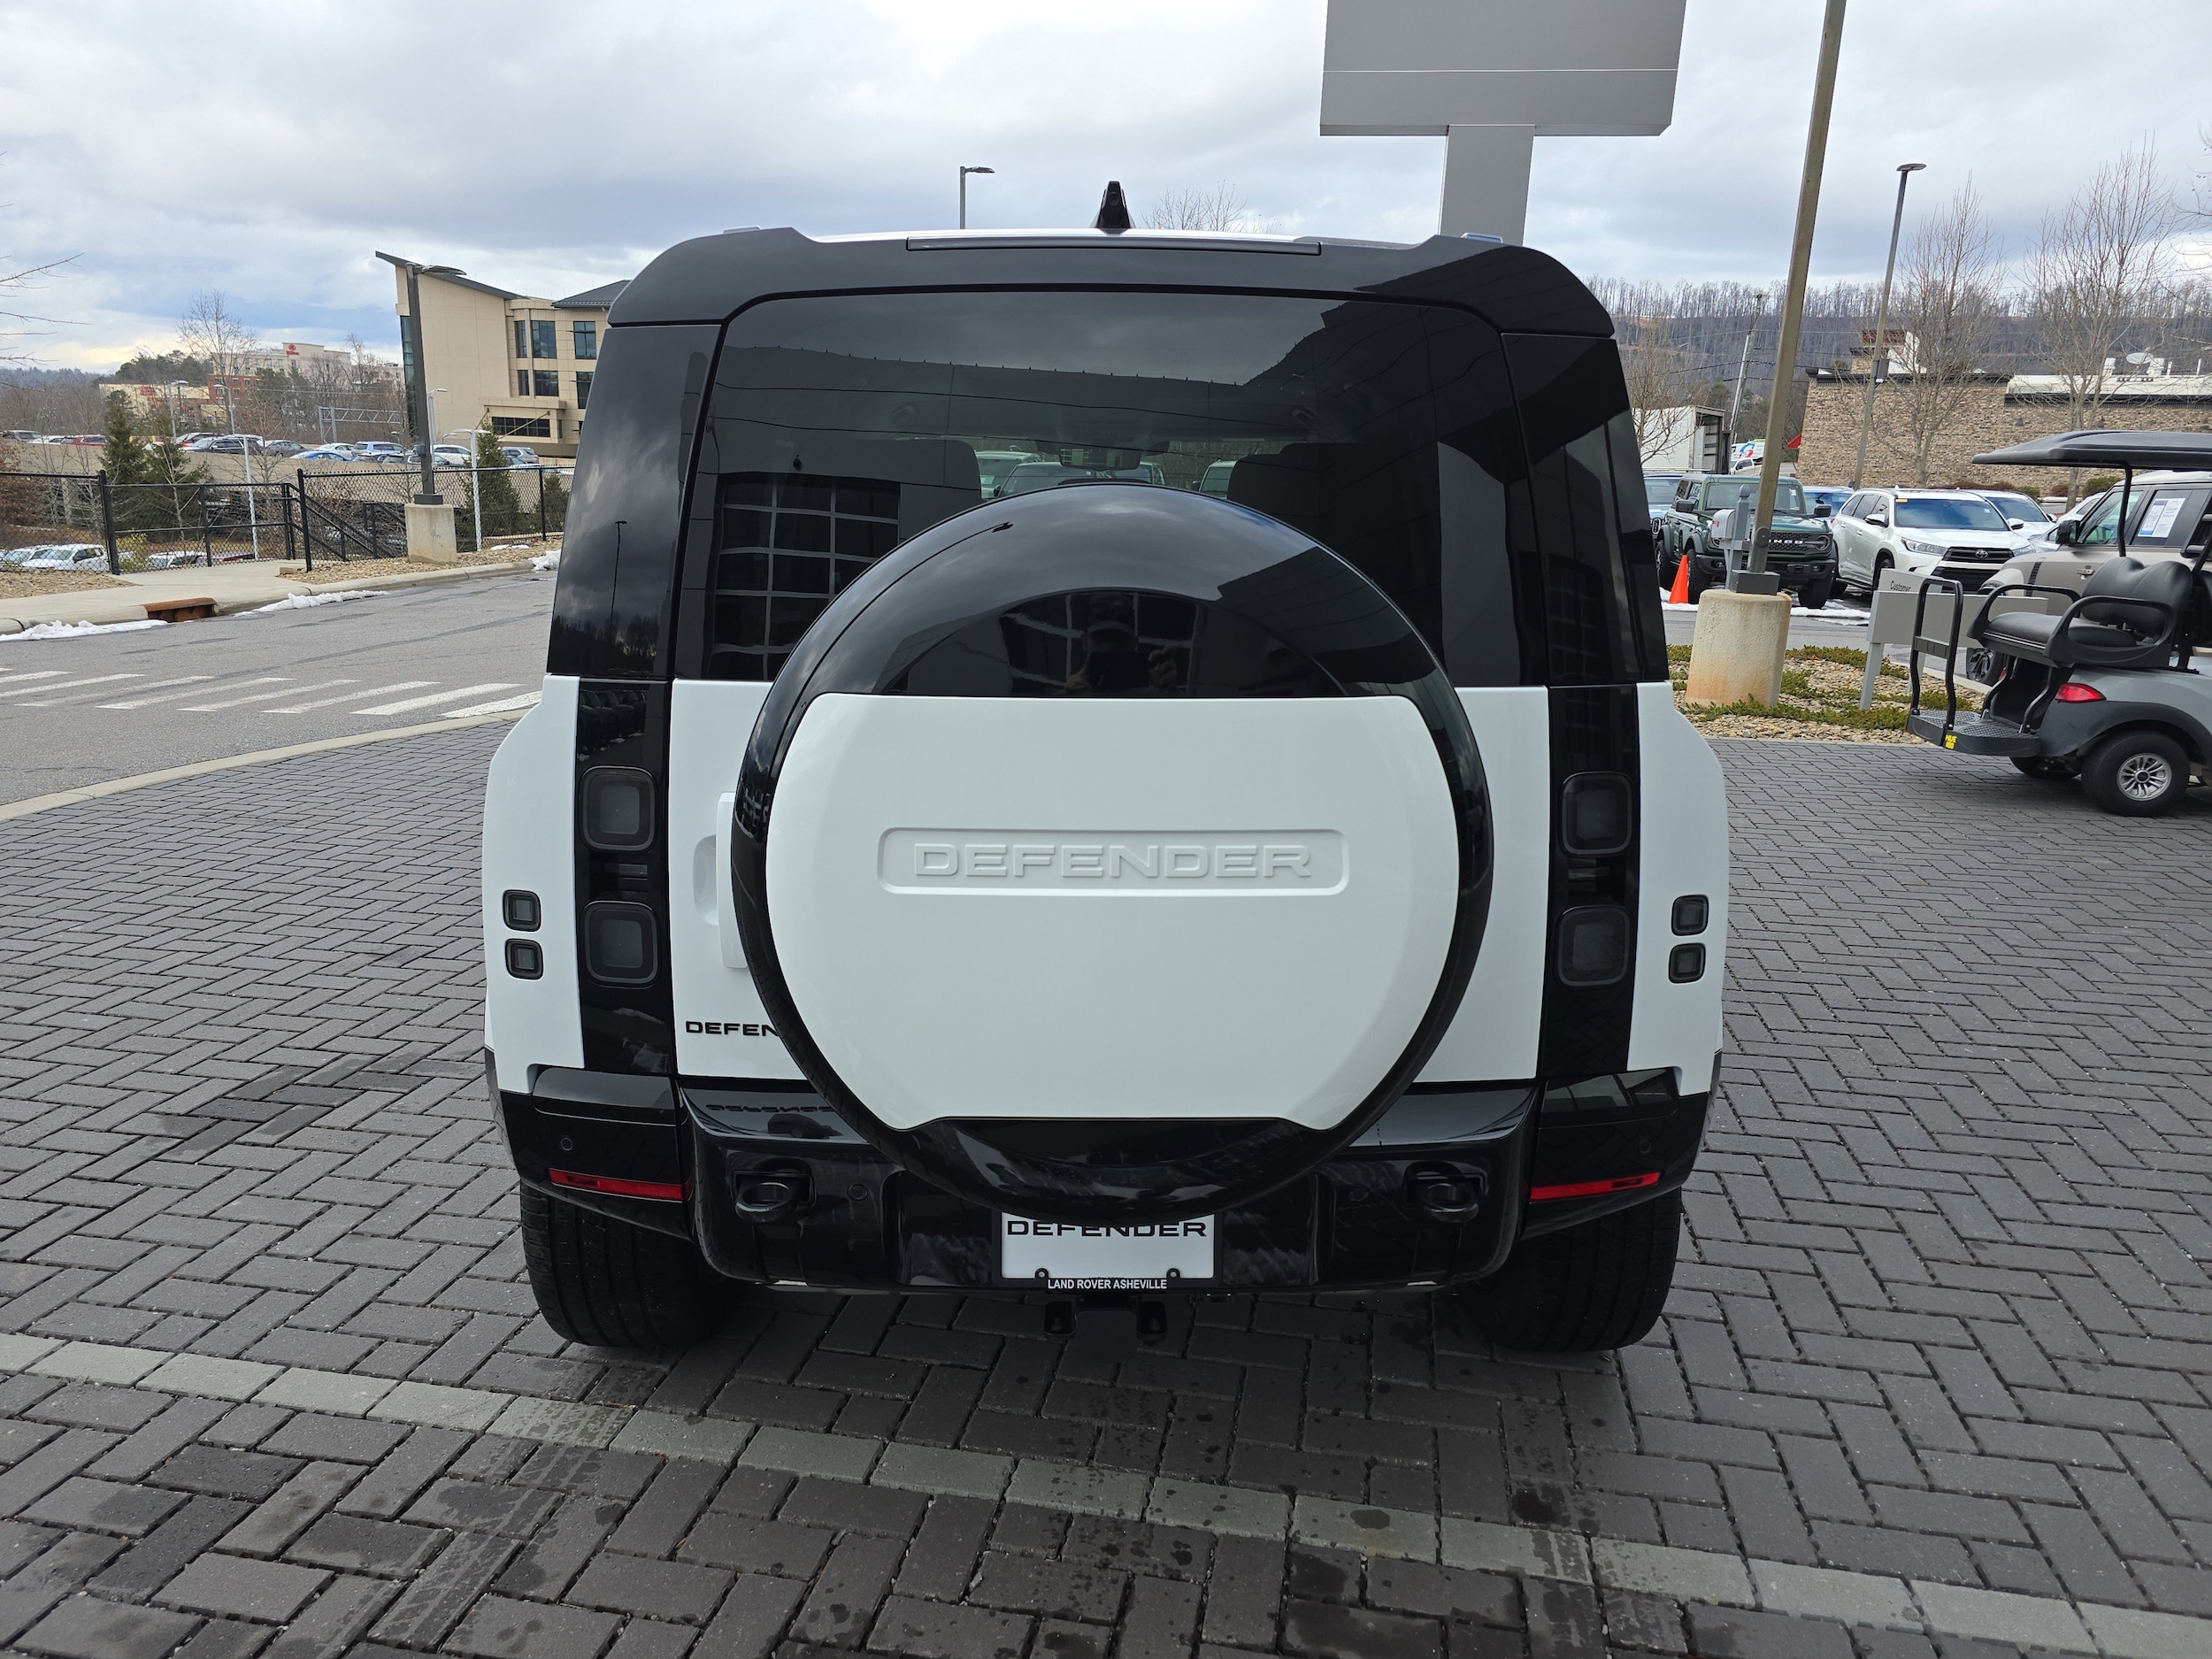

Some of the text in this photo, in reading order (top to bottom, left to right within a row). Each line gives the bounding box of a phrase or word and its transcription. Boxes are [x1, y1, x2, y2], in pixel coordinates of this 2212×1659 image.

[914, 843, 1311, 878] DEFENDER
[686, 1021, 779, 1036] DEFEN
[1048, 1279, 1167, 1289] LAND ROVER ASHEVILLE
